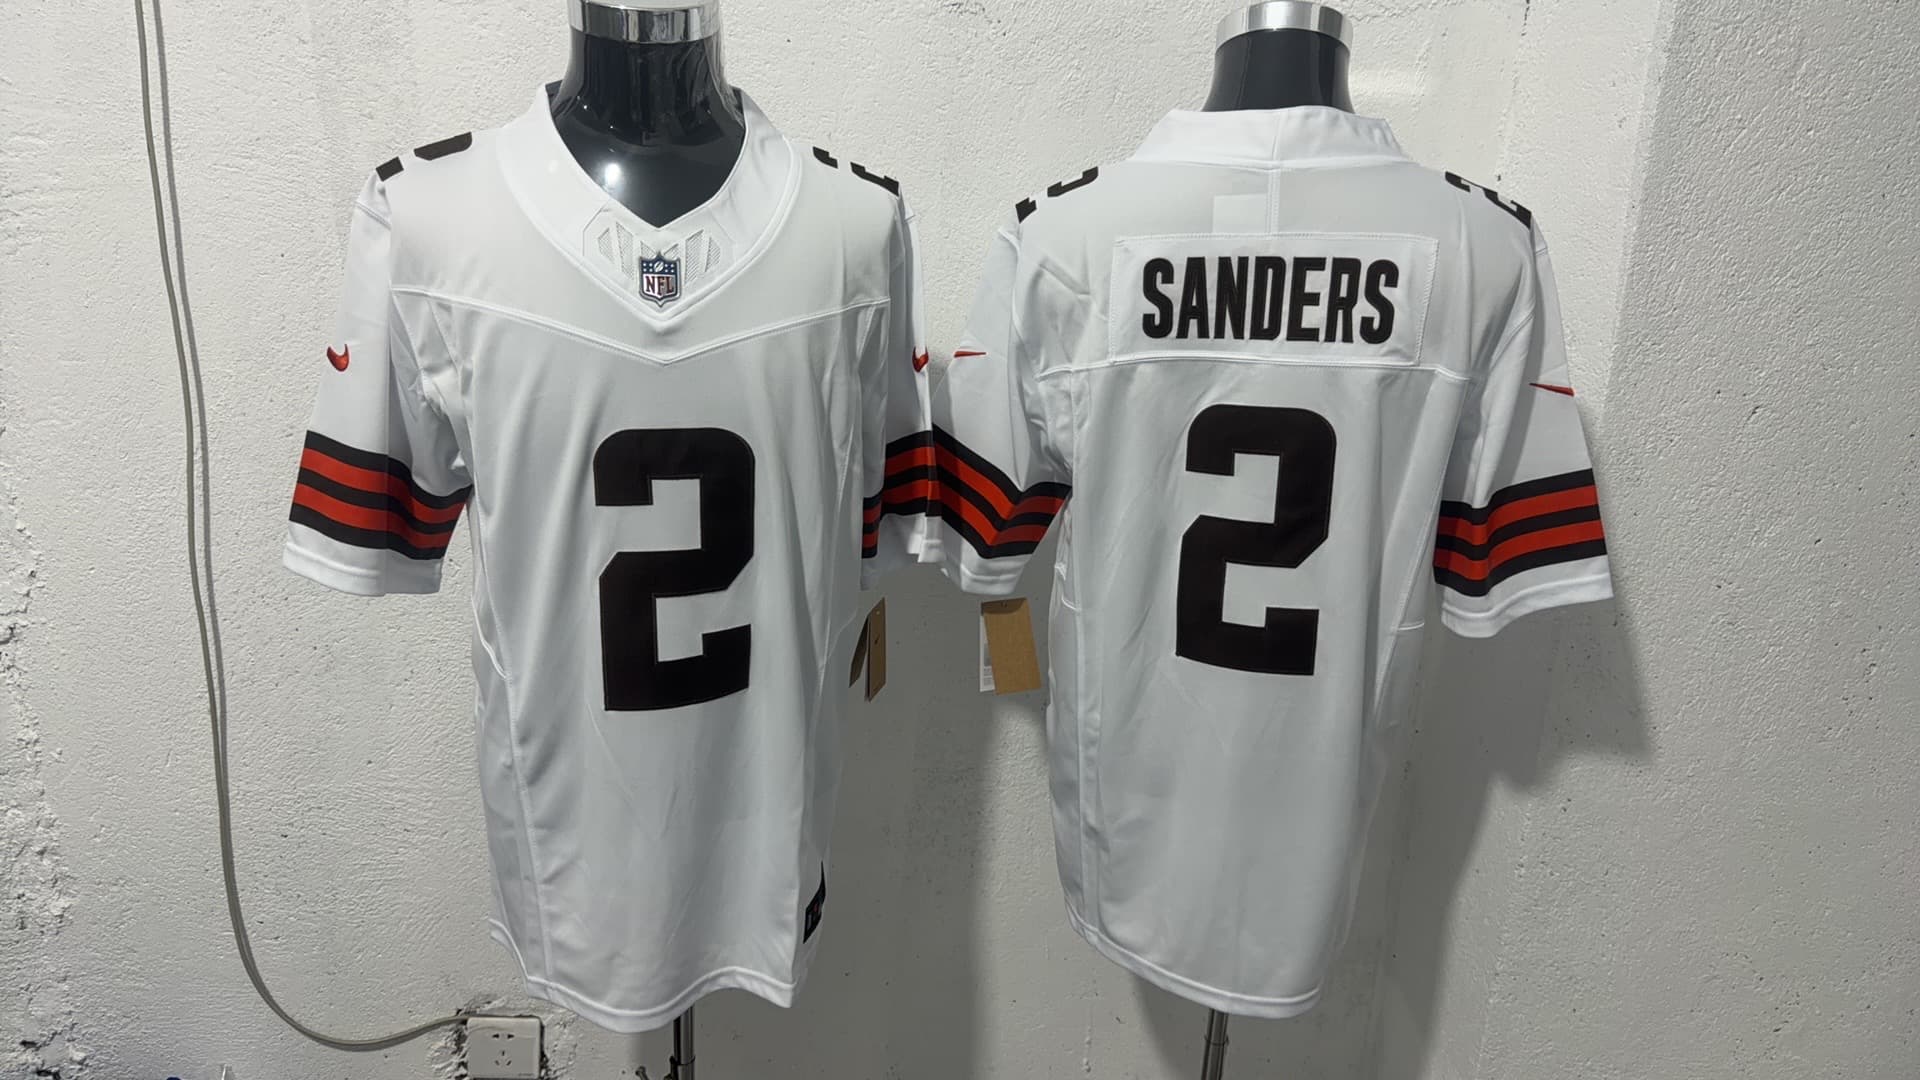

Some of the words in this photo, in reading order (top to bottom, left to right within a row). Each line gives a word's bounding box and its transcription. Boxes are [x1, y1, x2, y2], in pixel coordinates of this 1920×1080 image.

[645, 275, 674, 295] NFL
[1143, 257, 1399, 344] SANDERS
[593, 428, 755, 711] 2
[1176, 404, 1336, 676] 2
